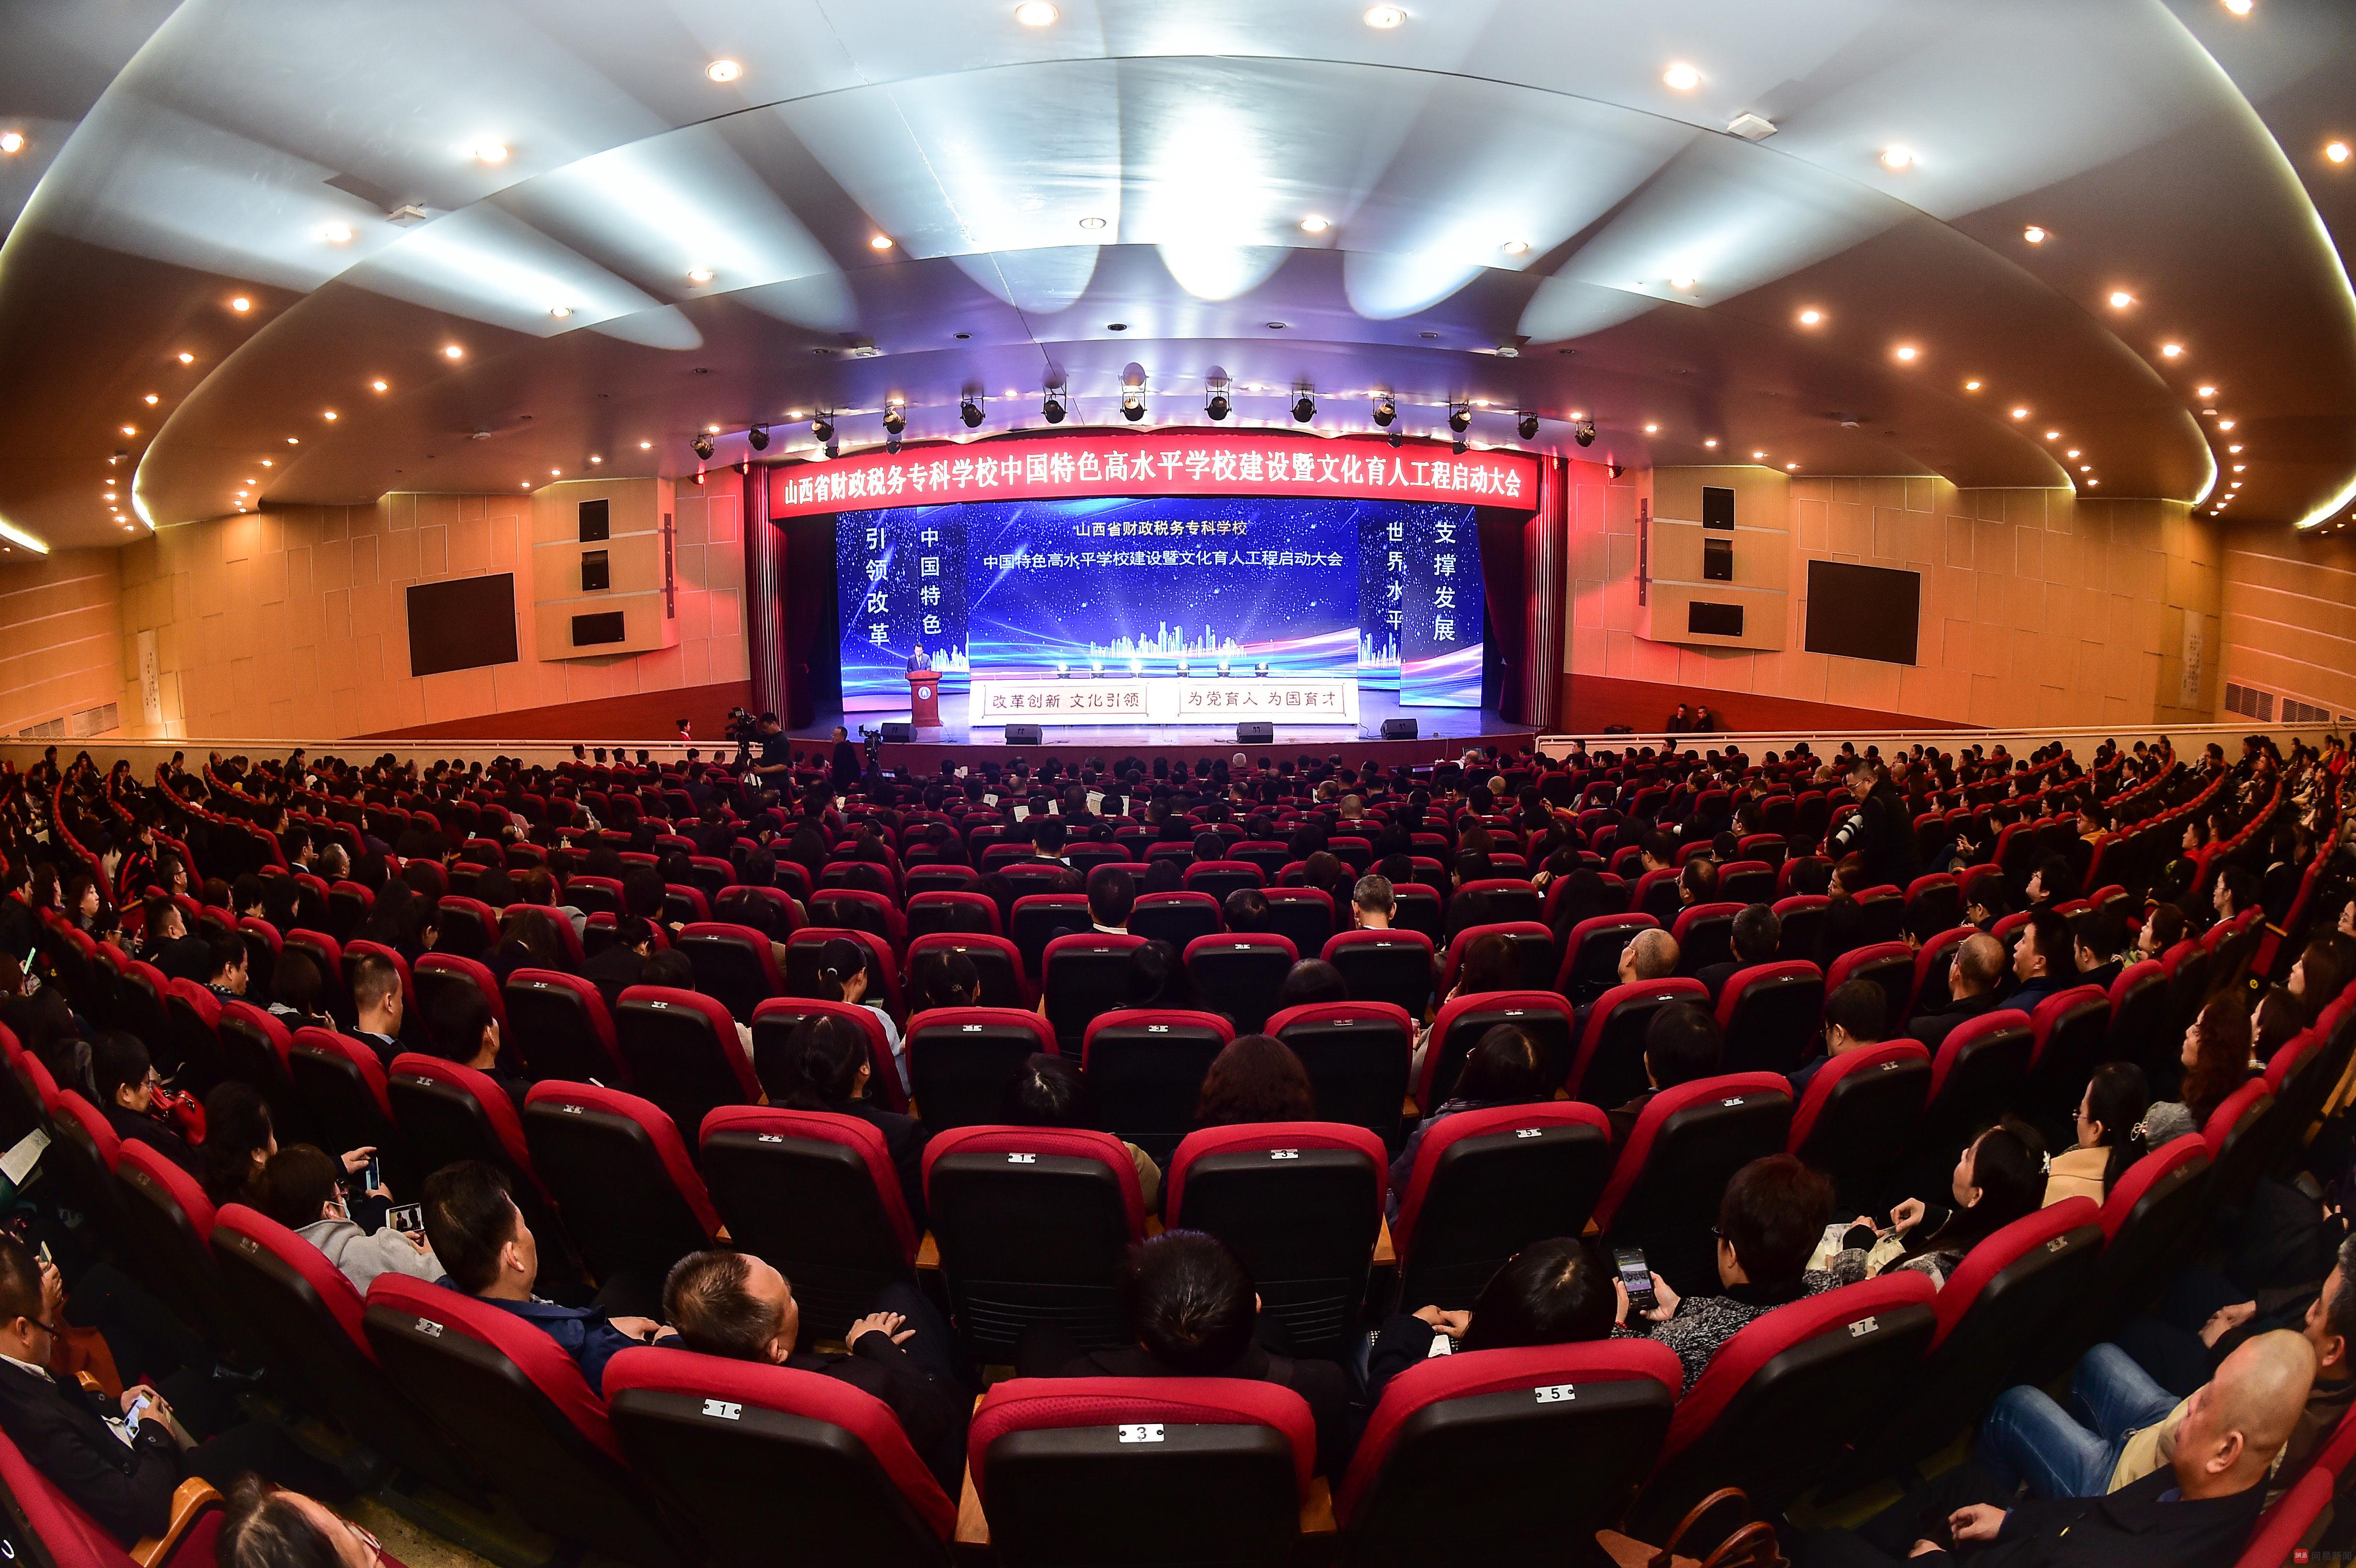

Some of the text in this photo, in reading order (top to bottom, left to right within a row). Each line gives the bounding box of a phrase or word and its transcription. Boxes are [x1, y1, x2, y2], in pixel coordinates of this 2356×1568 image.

[785, 449, 1521, 505] 山西省财政税务专科学校中国特色高水平学校建设暨文化育人工程启动大会
[1076, 520, 1247, 536] 山西省财政税务专科学校
[983, 550, 1343, 570] 中国特色高水平学校建设暨文化育人工程启动大会
[920, 527, 941, 634] 中国特色
[1386, 522, 1403, 630] 世界水平
[1433, 522, 1456, 641] 支撑发展
[866, 528, 890, 645] 引领改革
[993, 693, 1139, 708] 改革创新 文化引领
[1189, 691, 1335, 706] 为党育人 为国育才
[424, 1323, 433, 1332] 2
[1859, 1321, 1866, 1332] 7
[1551, 1388, 1560, 1399] 5
[720, 1404, 726, 1415] 1
[1137, 1426, 1147, 1440] 3
